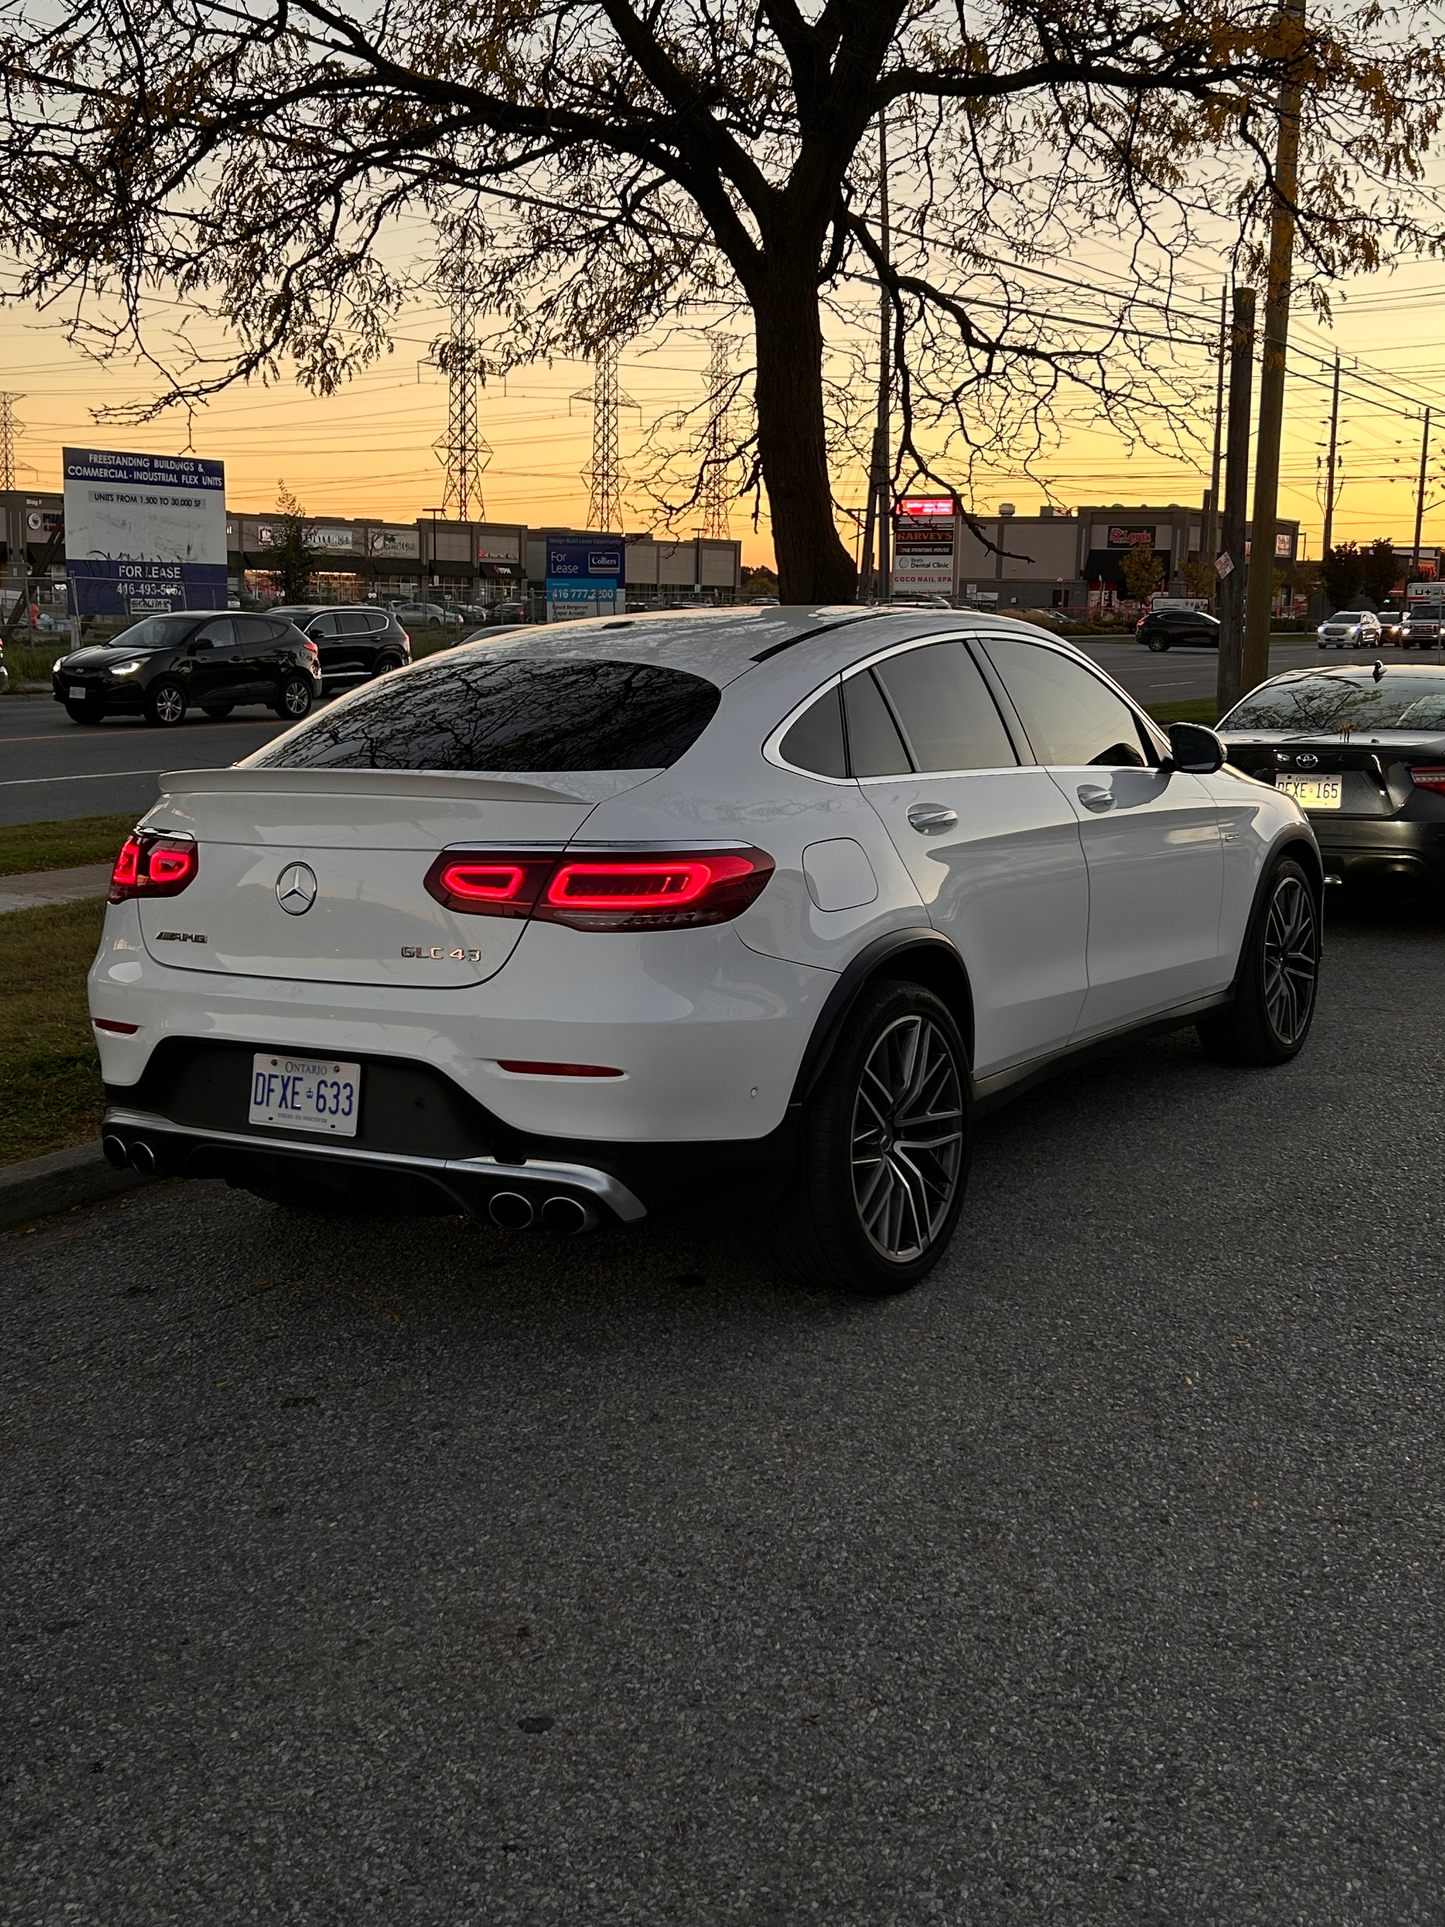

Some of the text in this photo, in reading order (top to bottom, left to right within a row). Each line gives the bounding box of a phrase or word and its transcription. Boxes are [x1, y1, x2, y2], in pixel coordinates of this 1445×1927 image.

[88, 453, 204, 473] FREESTANDING BUILDINGS &
[181, 474, 199, 485] FLEX
[202, 476, 223, 487] UNITS
[94, 493, 202, 508] UNITS FROM 1,500 TO 30,000 SF
[897, 532, 953, 540] HARVEY'S
[1121, 530, 1152, 546] Louis
[551, 551, 567, 562] For
[591, 556, 617, 565] Colliers
[119, 565, 181, 579] FOR LEASE
[551, 562, 579, 574] Lease
[552, 588, 569, 599] 416
[570, 588, 589, 599] 777
[1316, 782, 1339, 799] 165
[170, 932, 208, 944] AMG
[401, 946, 482, 962] GLC 43
[284, 1061, 328, 1076] ONTARIO
[253, 1072, 354, 1117] DFXE 633
[277, 1112, 294, 1120] YOURS
[302, 1115, 328, 1124] DISCOVER
